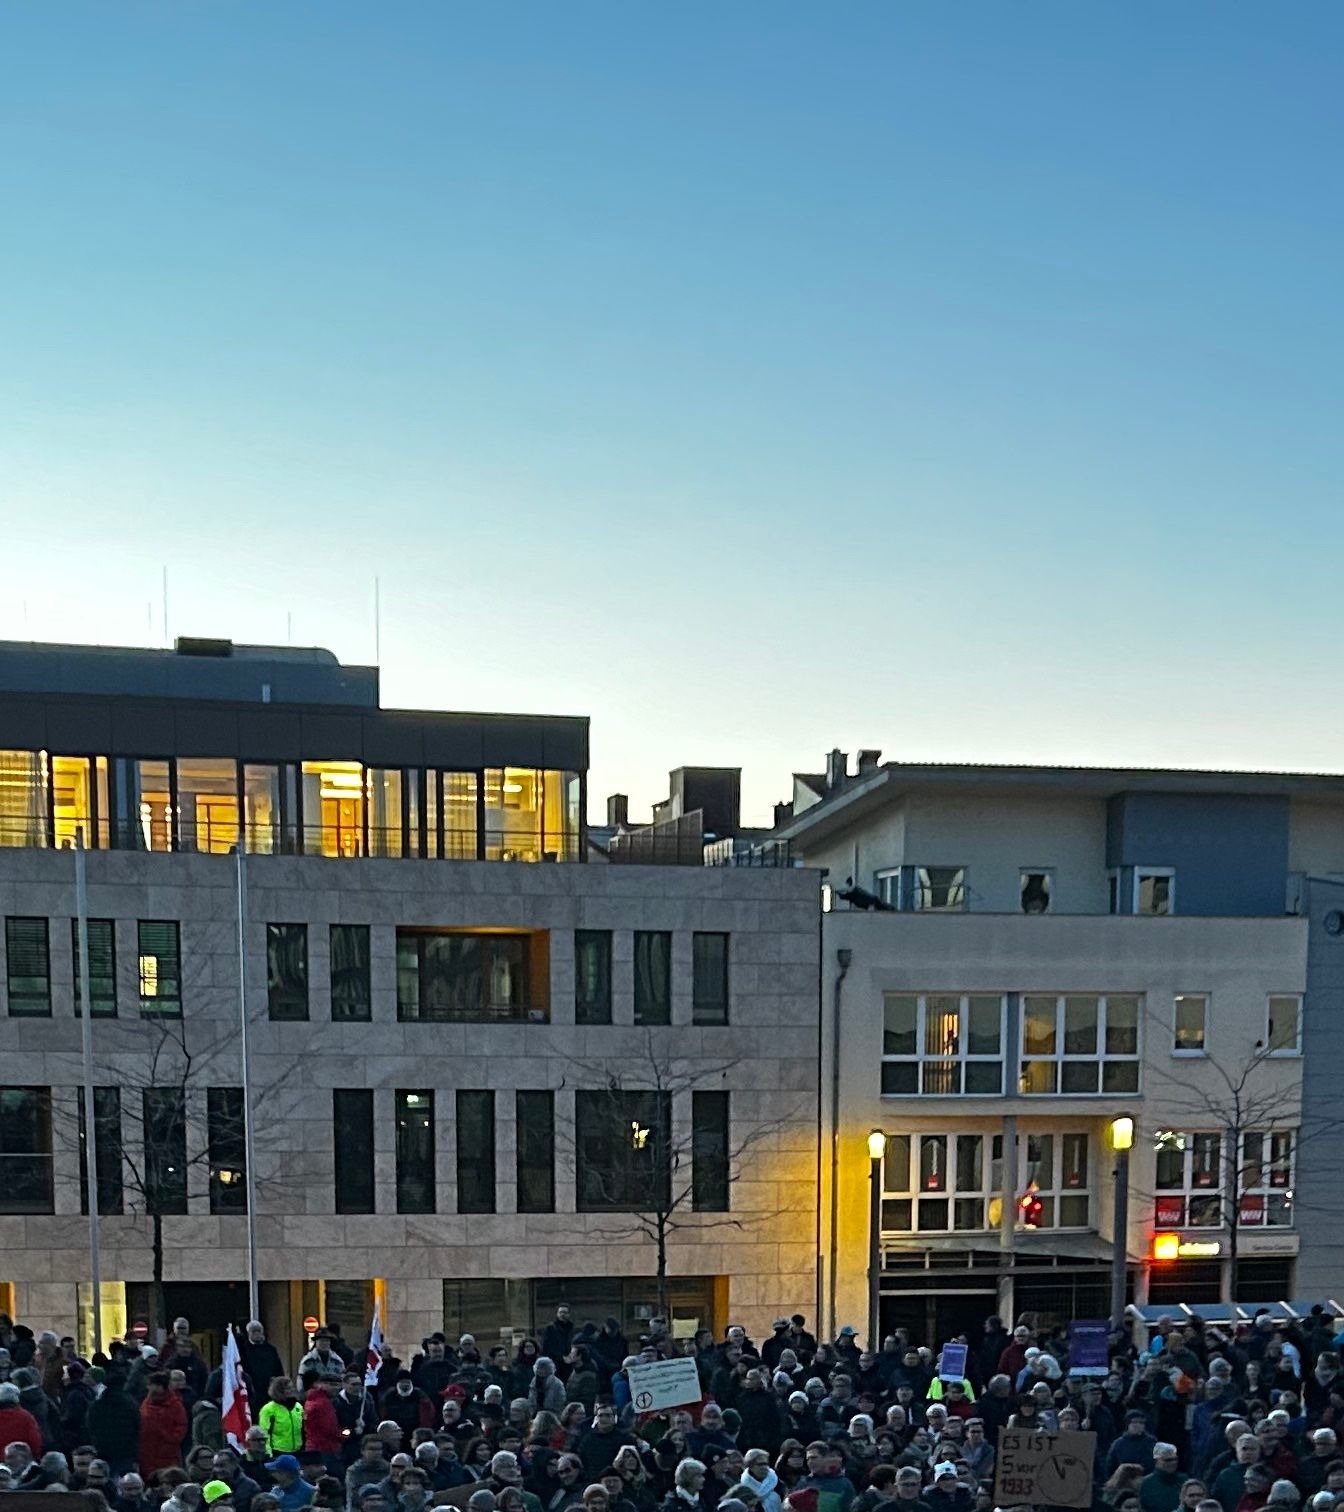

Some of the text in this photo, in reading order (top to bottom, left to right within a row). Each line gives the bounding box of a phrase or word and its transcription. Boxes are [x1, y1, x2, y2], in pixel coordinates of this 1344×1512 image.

[1002, 1435, 1058, 1451] ES IST
[1002, 1454, 1014, 1474] 5
[1000, 1478, 1034, 1495] 1933
